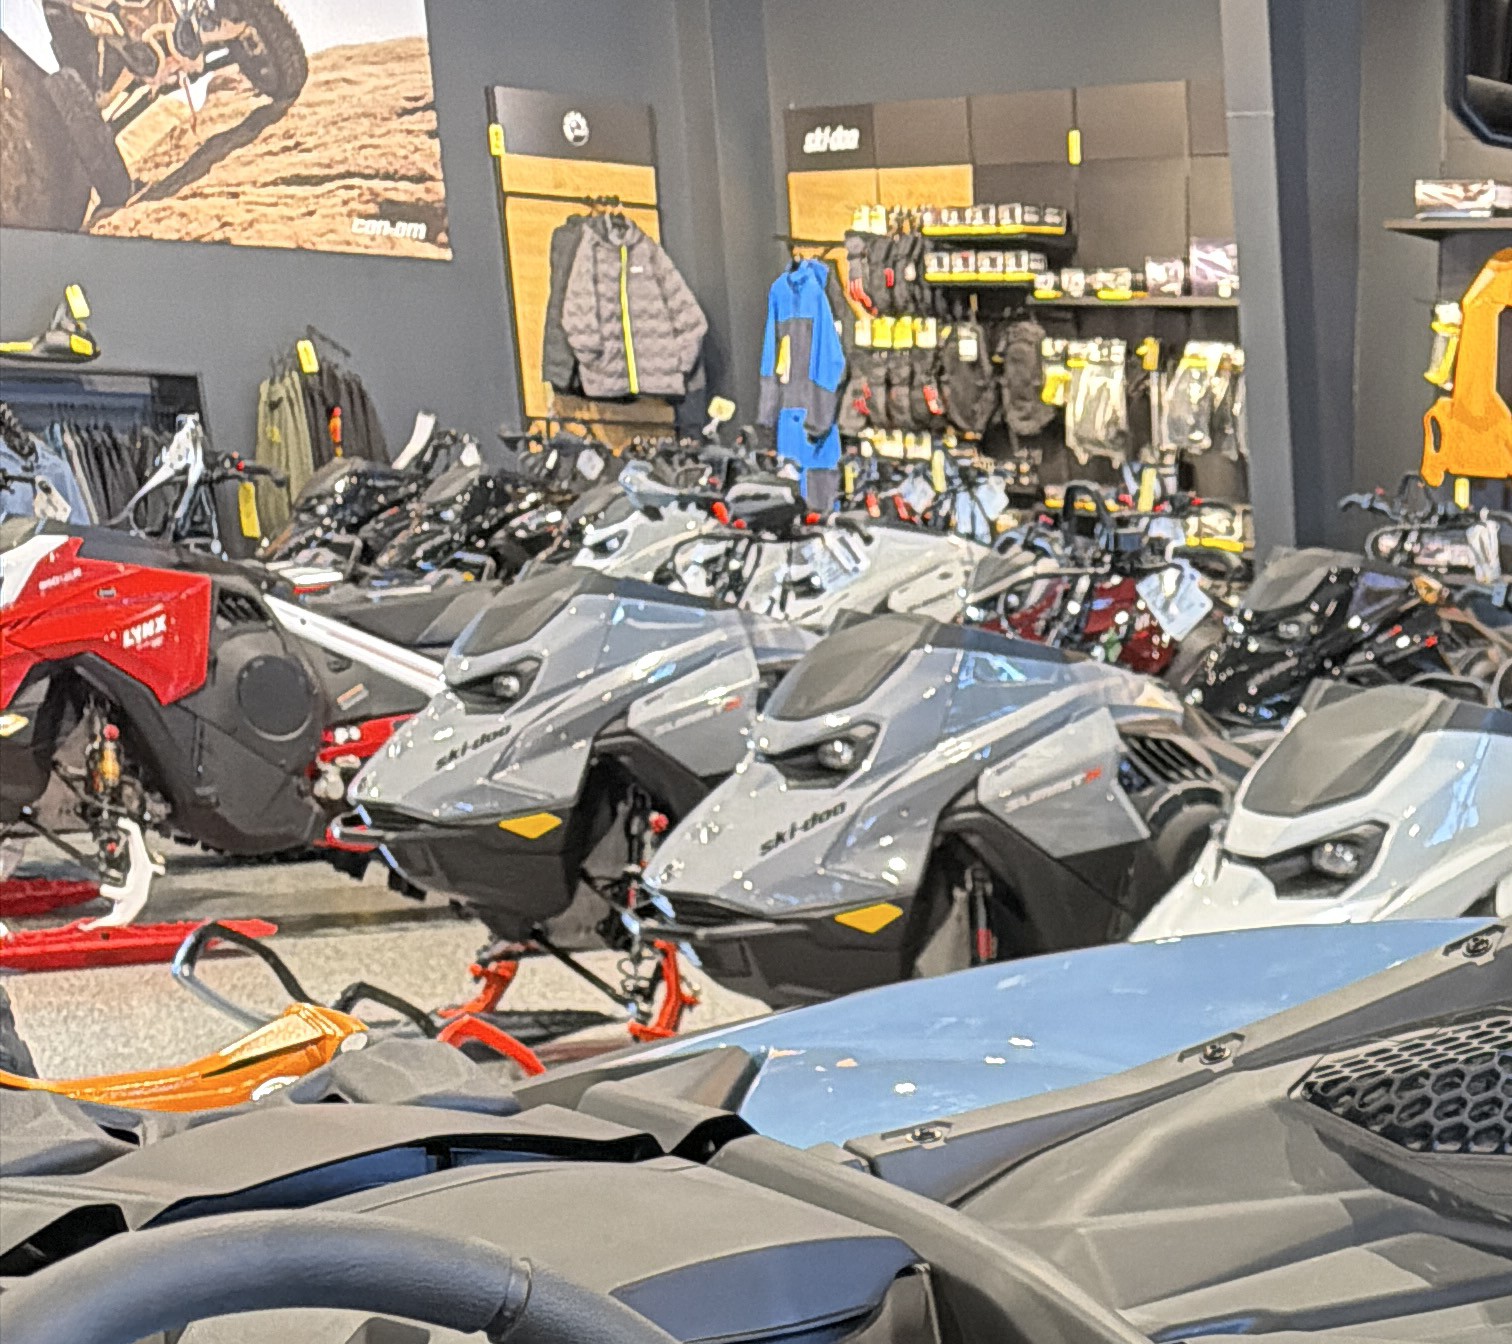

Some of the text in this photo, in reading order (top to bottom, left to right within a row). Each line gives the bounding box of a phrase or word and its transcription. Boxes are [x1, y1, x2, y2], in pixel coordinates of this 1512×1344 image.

[351, 217, 427, 240] can-am
[122, 613, 167, 649] LYNX
[435, 724, 512, 771] ski-doo
[759, 802, 847, 856] ski-doo
